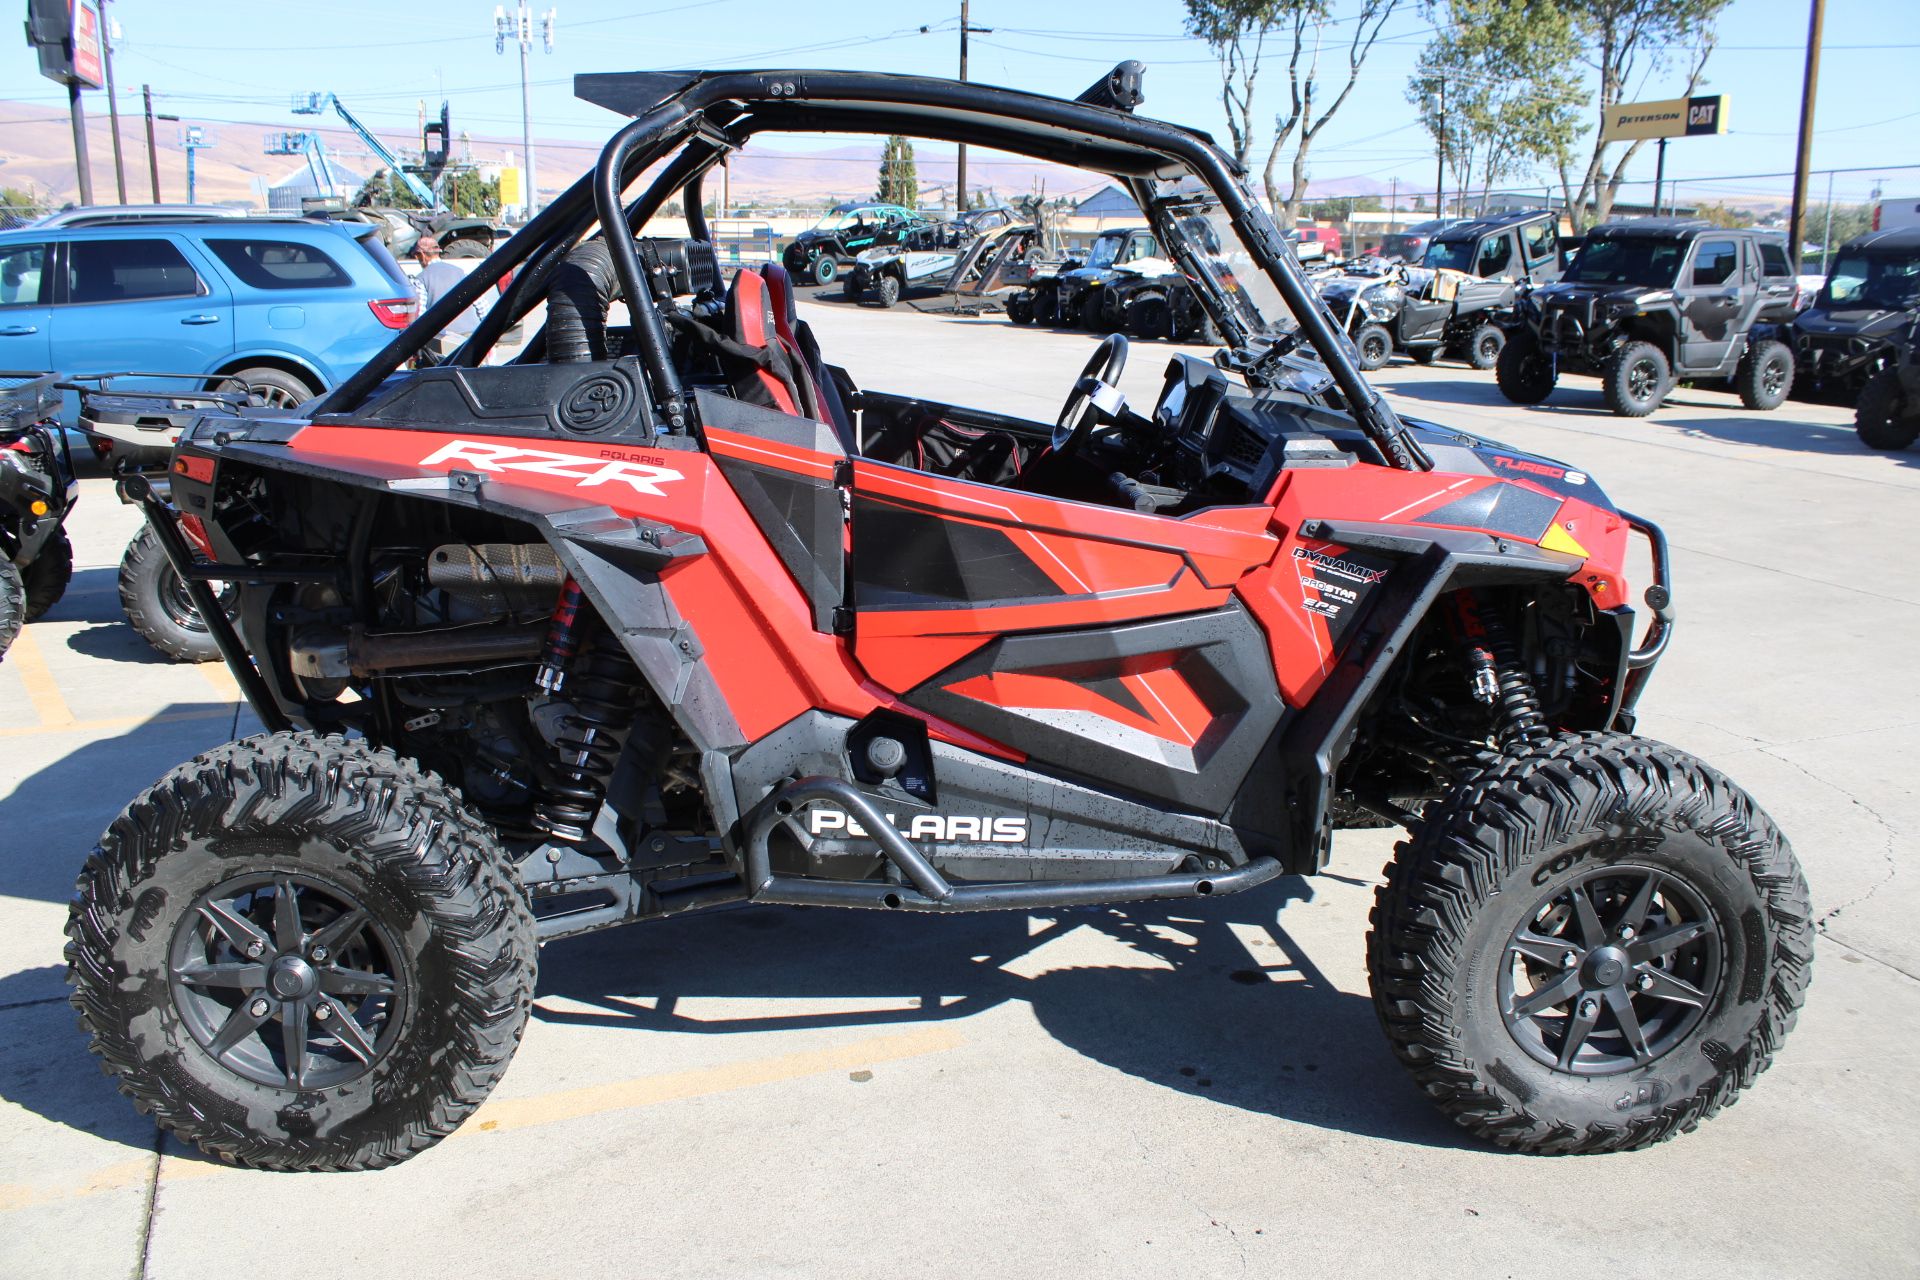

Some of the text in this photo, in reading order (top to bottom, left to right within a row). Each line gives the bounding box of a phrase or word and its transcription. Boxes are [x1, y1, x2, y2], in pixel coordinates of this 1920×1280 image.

[1617, 104, 1716, 128] PETERSON CAT
[418, 440, 686, 497] RZR
[600, 450, 665, 466] POLARIS
[1494, 456, 1587, 485] TURBO S
[1291, 546, 1388, 584] DYNAMIX
[1301, 576, 1357, 600] PROSTAR
[1303, 598, 1340, 613] EPS
[811, 809, 1026, 842] PARIS
